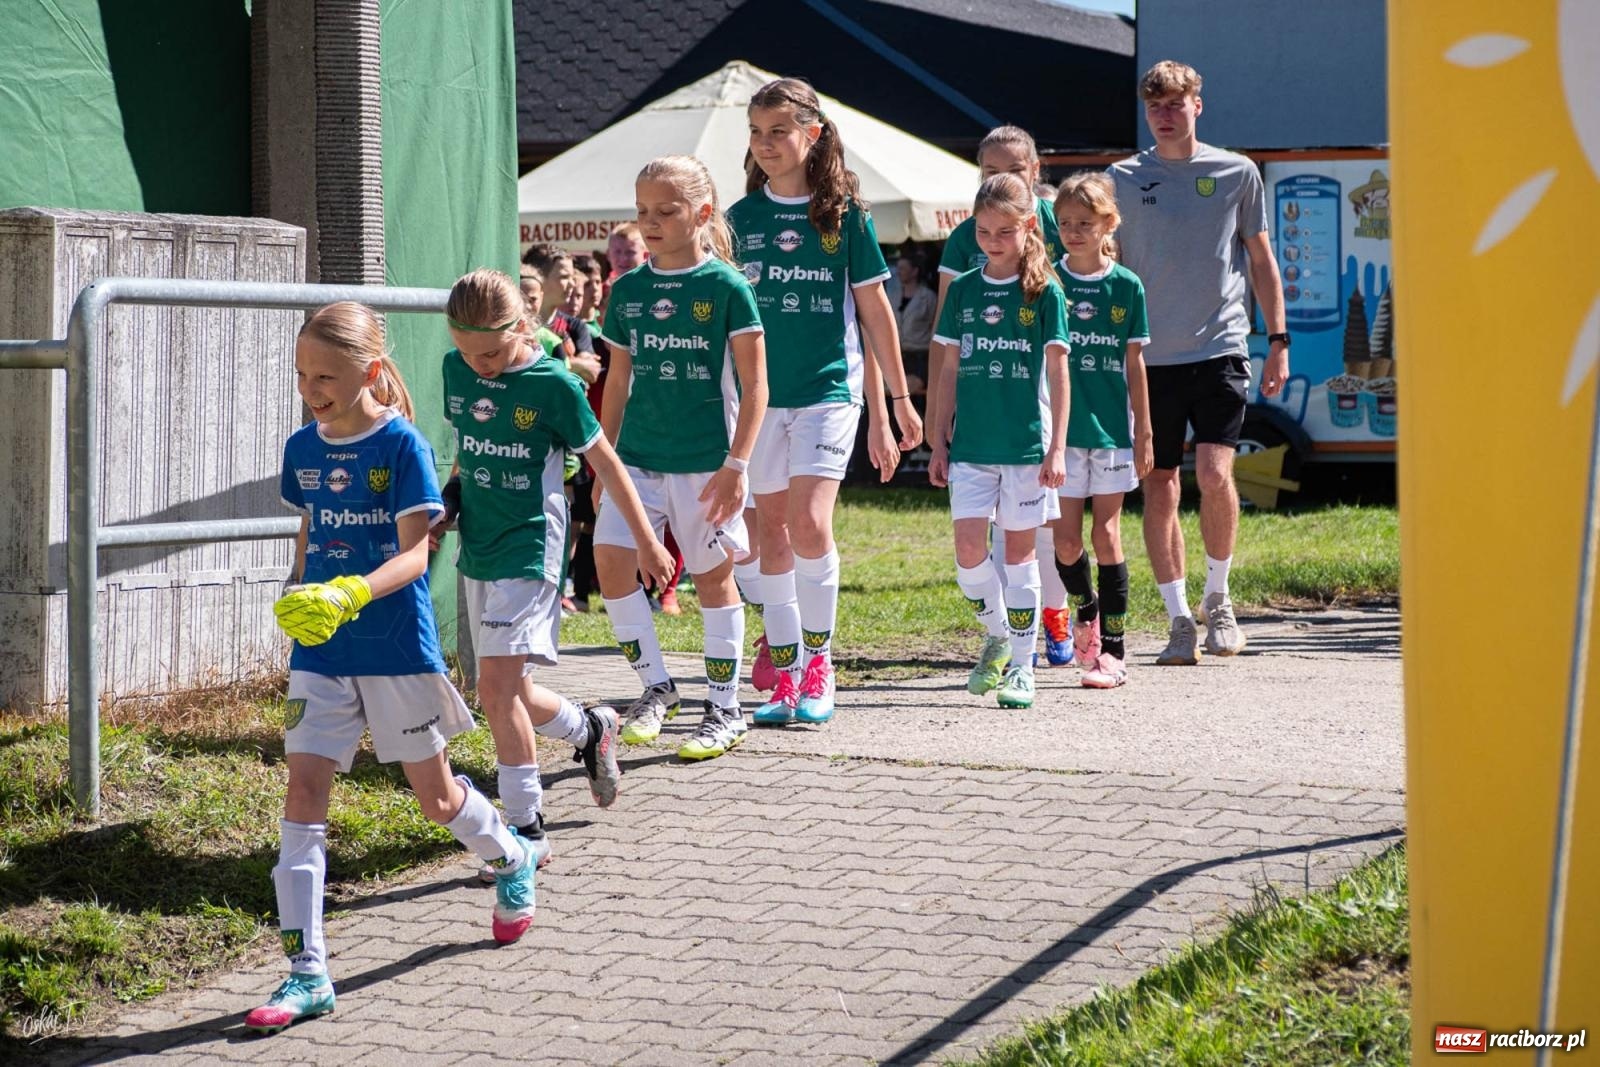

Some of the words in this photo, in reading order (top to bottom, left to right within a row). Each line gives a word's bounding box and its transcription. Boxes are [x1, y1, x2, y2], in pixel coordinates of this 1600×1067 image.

[1142, 196, 1157, 205] HB
[774, 213, 808, 221] regio
[520, 219, 638, 243] RACIBORS
[768, 265, 834, 283] Rybnik
[652, 281, 683, 290] regio
[1072, 287, 1101, 295] regio
[643, 333, 710, 352] Rybnik
[976, 336, 1033, 353] Rybnik
[476, 377, 508, 390] regio
[463, 435, 532, 459] Rybnik
[815, 443, 846, 457] regio
[326, 452, 358, 461] regio
[1018, 493, 1046, 508] regio
[320, 508, 392, 529] Rybnik
[327, 549, 349, 559] PGE
[480, 620, 513, 629] regio
[402, 714, 441, 735] regio
